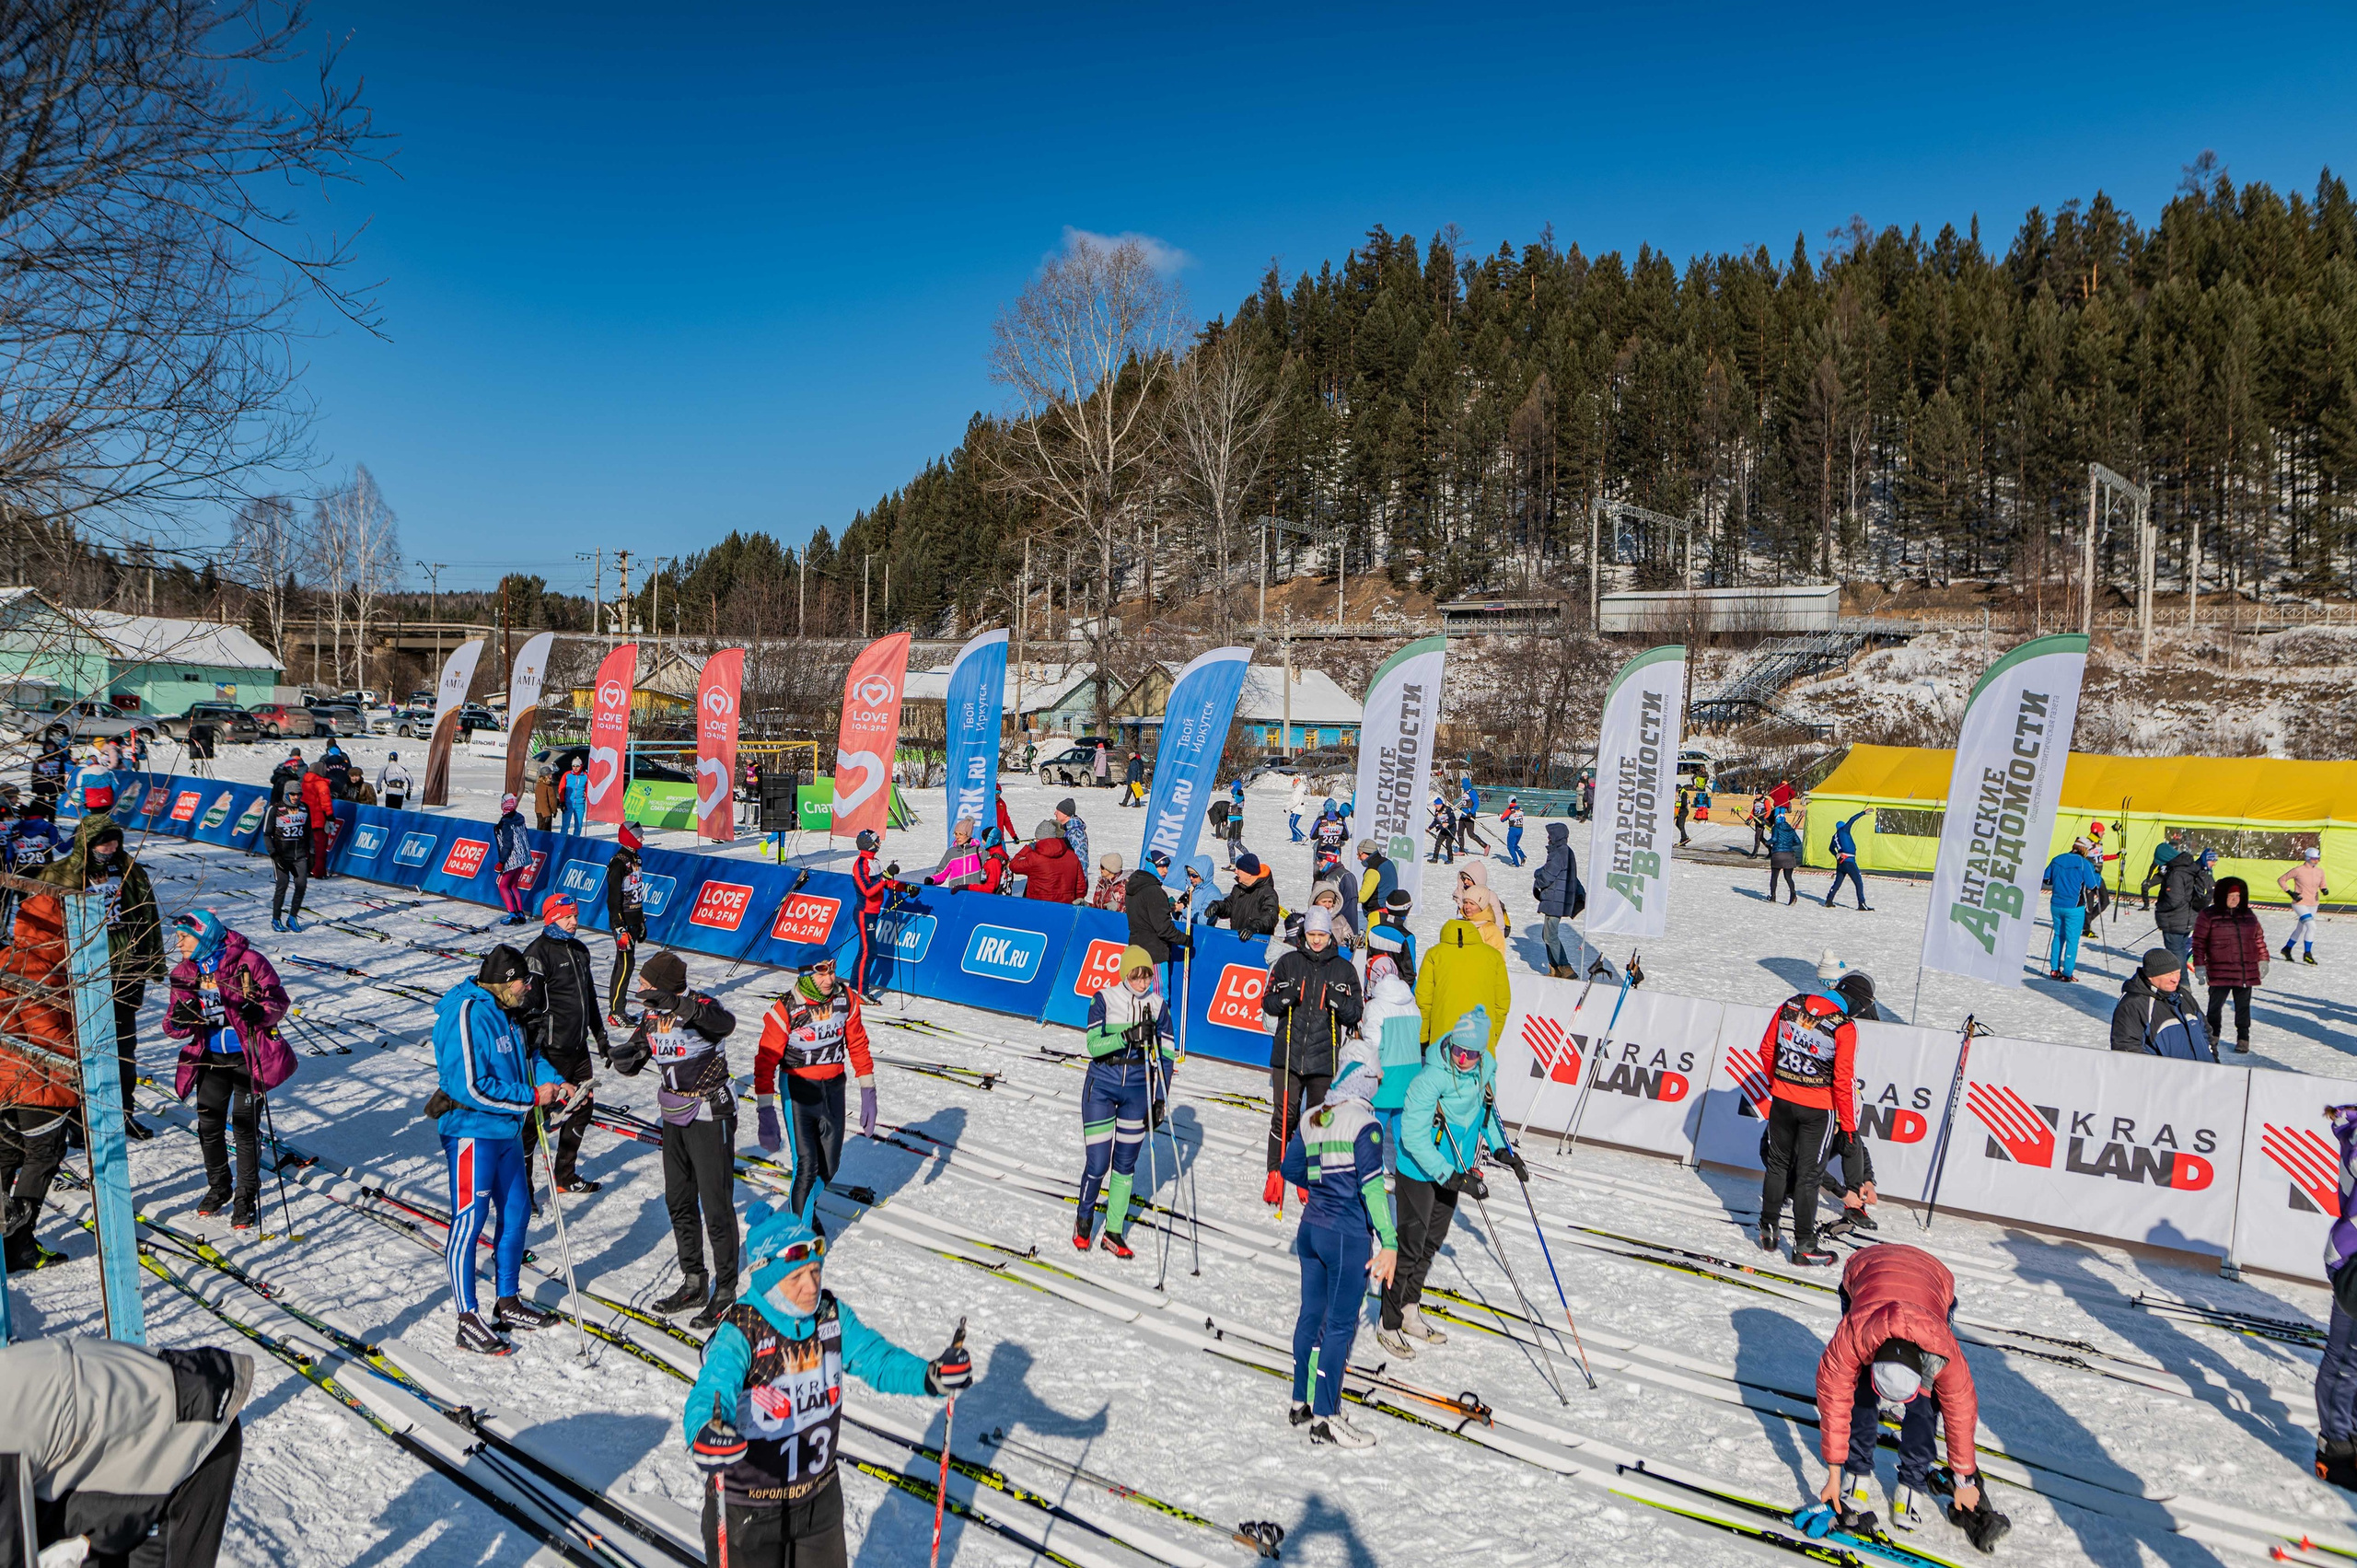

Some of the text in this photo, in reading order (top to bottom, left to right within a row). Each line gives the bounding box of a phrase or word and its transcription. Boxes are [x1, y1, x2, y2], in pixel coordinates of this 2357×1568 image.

[853, 710, 888, 724] LOVE
[963, 703, 974, 730] Твой
[976, 683, 989, 731] Иркутск
[598, 712, 622, 724] LOVE
[704, 720, 727, 733] LOVE
[852, 723, 887, 732] 104.2FM
[1191, 701, 1214, 753] Иркутск
[1177, 718, 1194, 749] Твой
[1387, 682, 1422, 863] ВЕДОМОСТИ
[1631, 690, 1663, 880] ВЕДОМОСТИ
[804, 801, 833, 814] Слат
[1982, 689, 2049, 921] ВЕДОМОСТИ
[283, 827, 304, 838] 326
[355, 831, 379, 851] IRK.RU
[1322, 836, 1339, 844] 267
[454, 843, 484, 861] LOVE
[447, 859, 476, 873] 104.2FM
[563, 868, 596, 892] IRK.RU
[702, 888, 745, 909] LOVE
[697, 907, 737, 923] 104.2FM
[786, 900, 832, 923] LOVE
[779, 921, 824, 938] 104.2FM
[975, 937, 1030, 970] IRK.RU
[1092, 949, 1122, 971] LO
[1226, 973, 1263, 999] LO
[1220, 1001, 1263, 1024] 104.2
[819, 1021, 844, 1031] KRAS
[819, 1027, 843, 1040] LAND
[1793, 1036, 1819, 1055] LAND
[1795, 1029, 1821, 1047] KRAS
[658, 1046, 687, 1057] LAND
[802, 1044, 844, 1065] 146
[1594, 1038, 1695, 1073] KRAS
[1778, 1048, 1817, 1075] 286
[1588, 1058, 1689, 1103] LAND
[1858, 1103, 1927, 1144] ND
[2070, 1109, 2217, 1154] KRAS
[2065, 1136, 2214, 1192] LAND
[502, 1308, 541, 1326] NANO
[780, 1426, 831, 1482] 13
[1805, 1548, 1841, 1565] FISCHER
